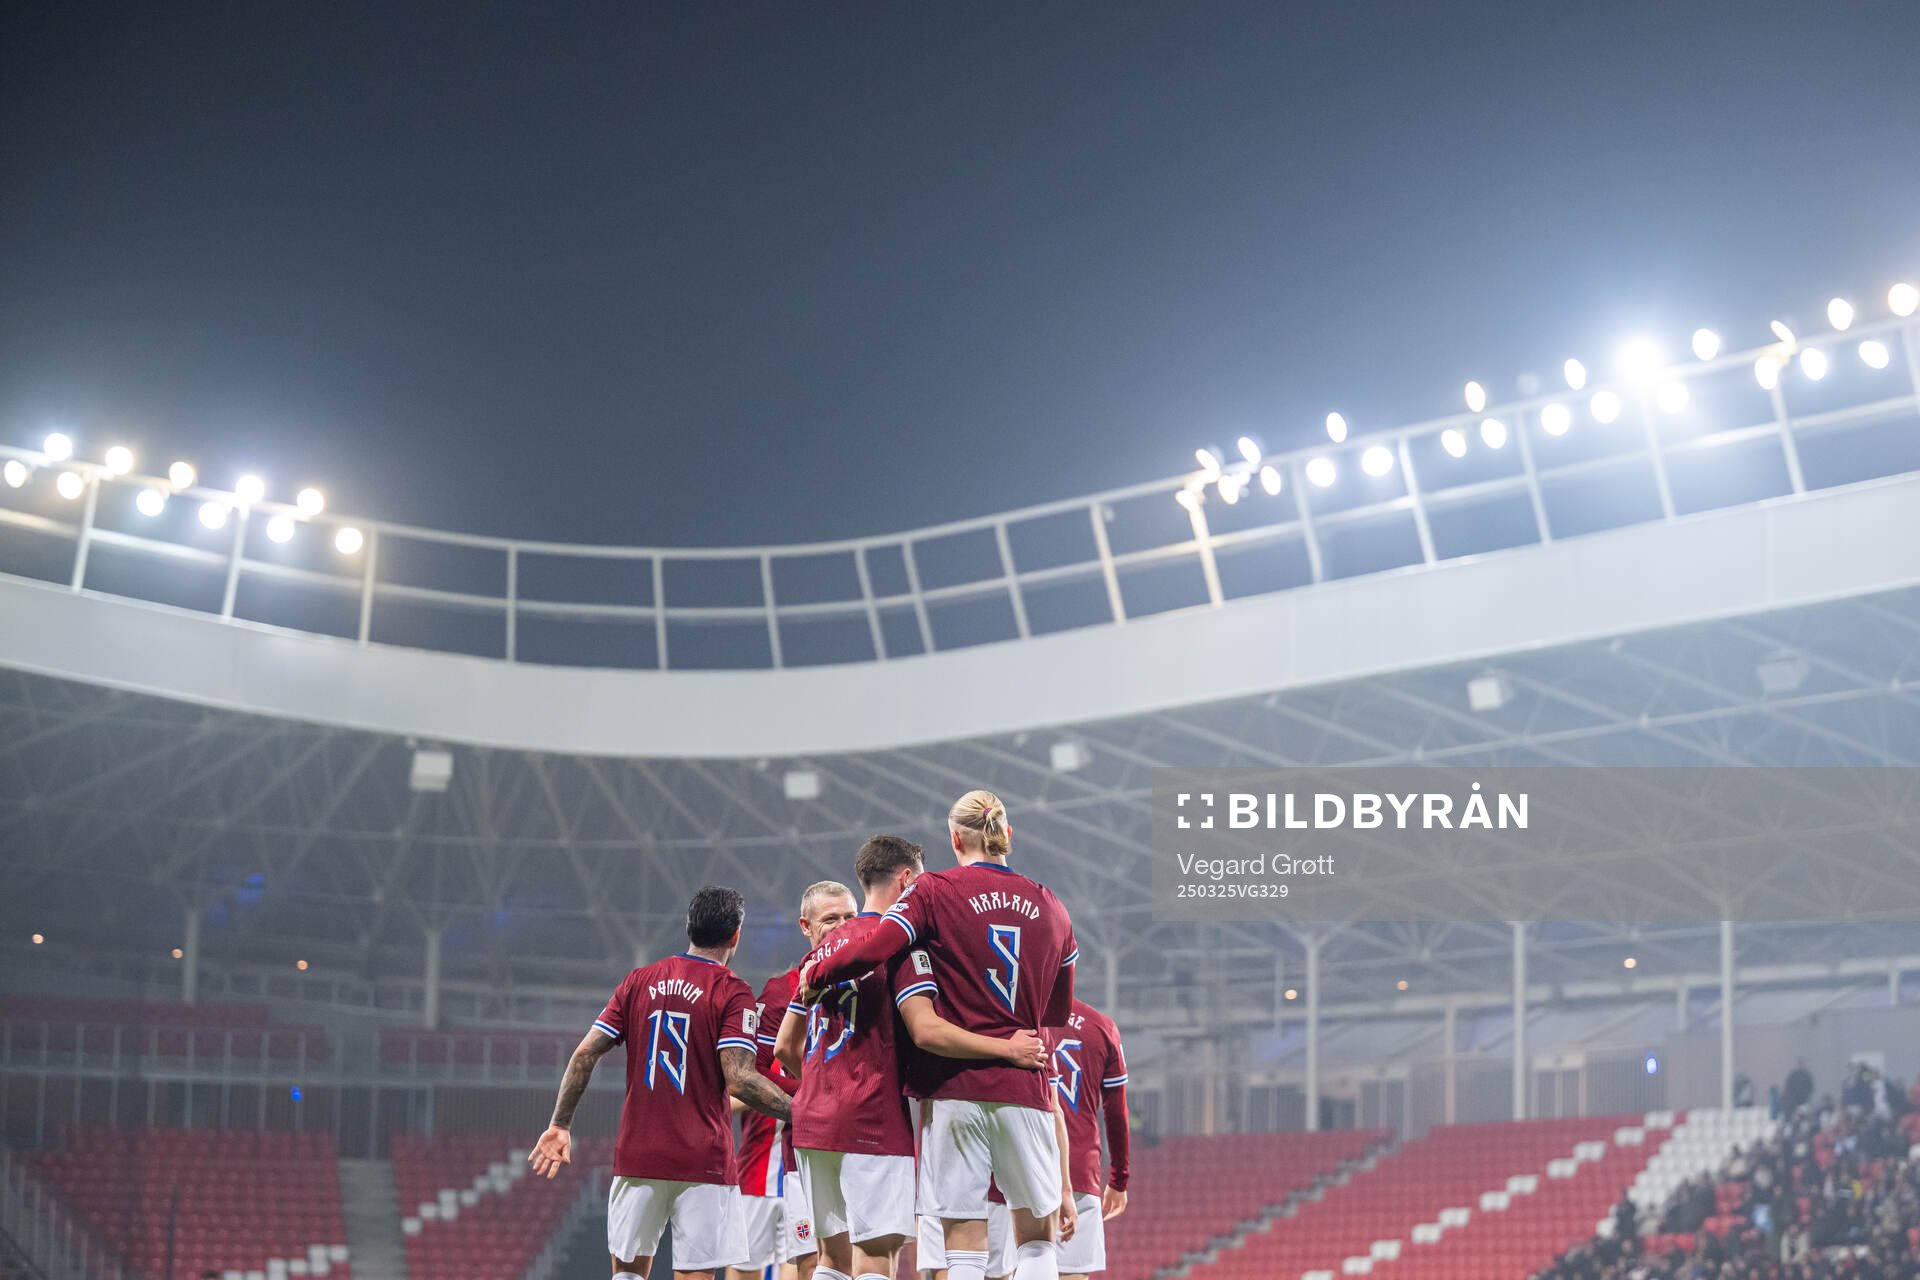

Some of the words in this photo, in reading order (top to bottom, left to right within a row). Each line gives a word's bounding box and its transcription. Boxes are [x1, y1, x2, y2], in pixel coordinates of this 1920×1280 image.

[968, 892, 1040, 920] HAALAND
[985, 923, 1021, 1015] 9
[644, 1009, 691, 1096] 19
